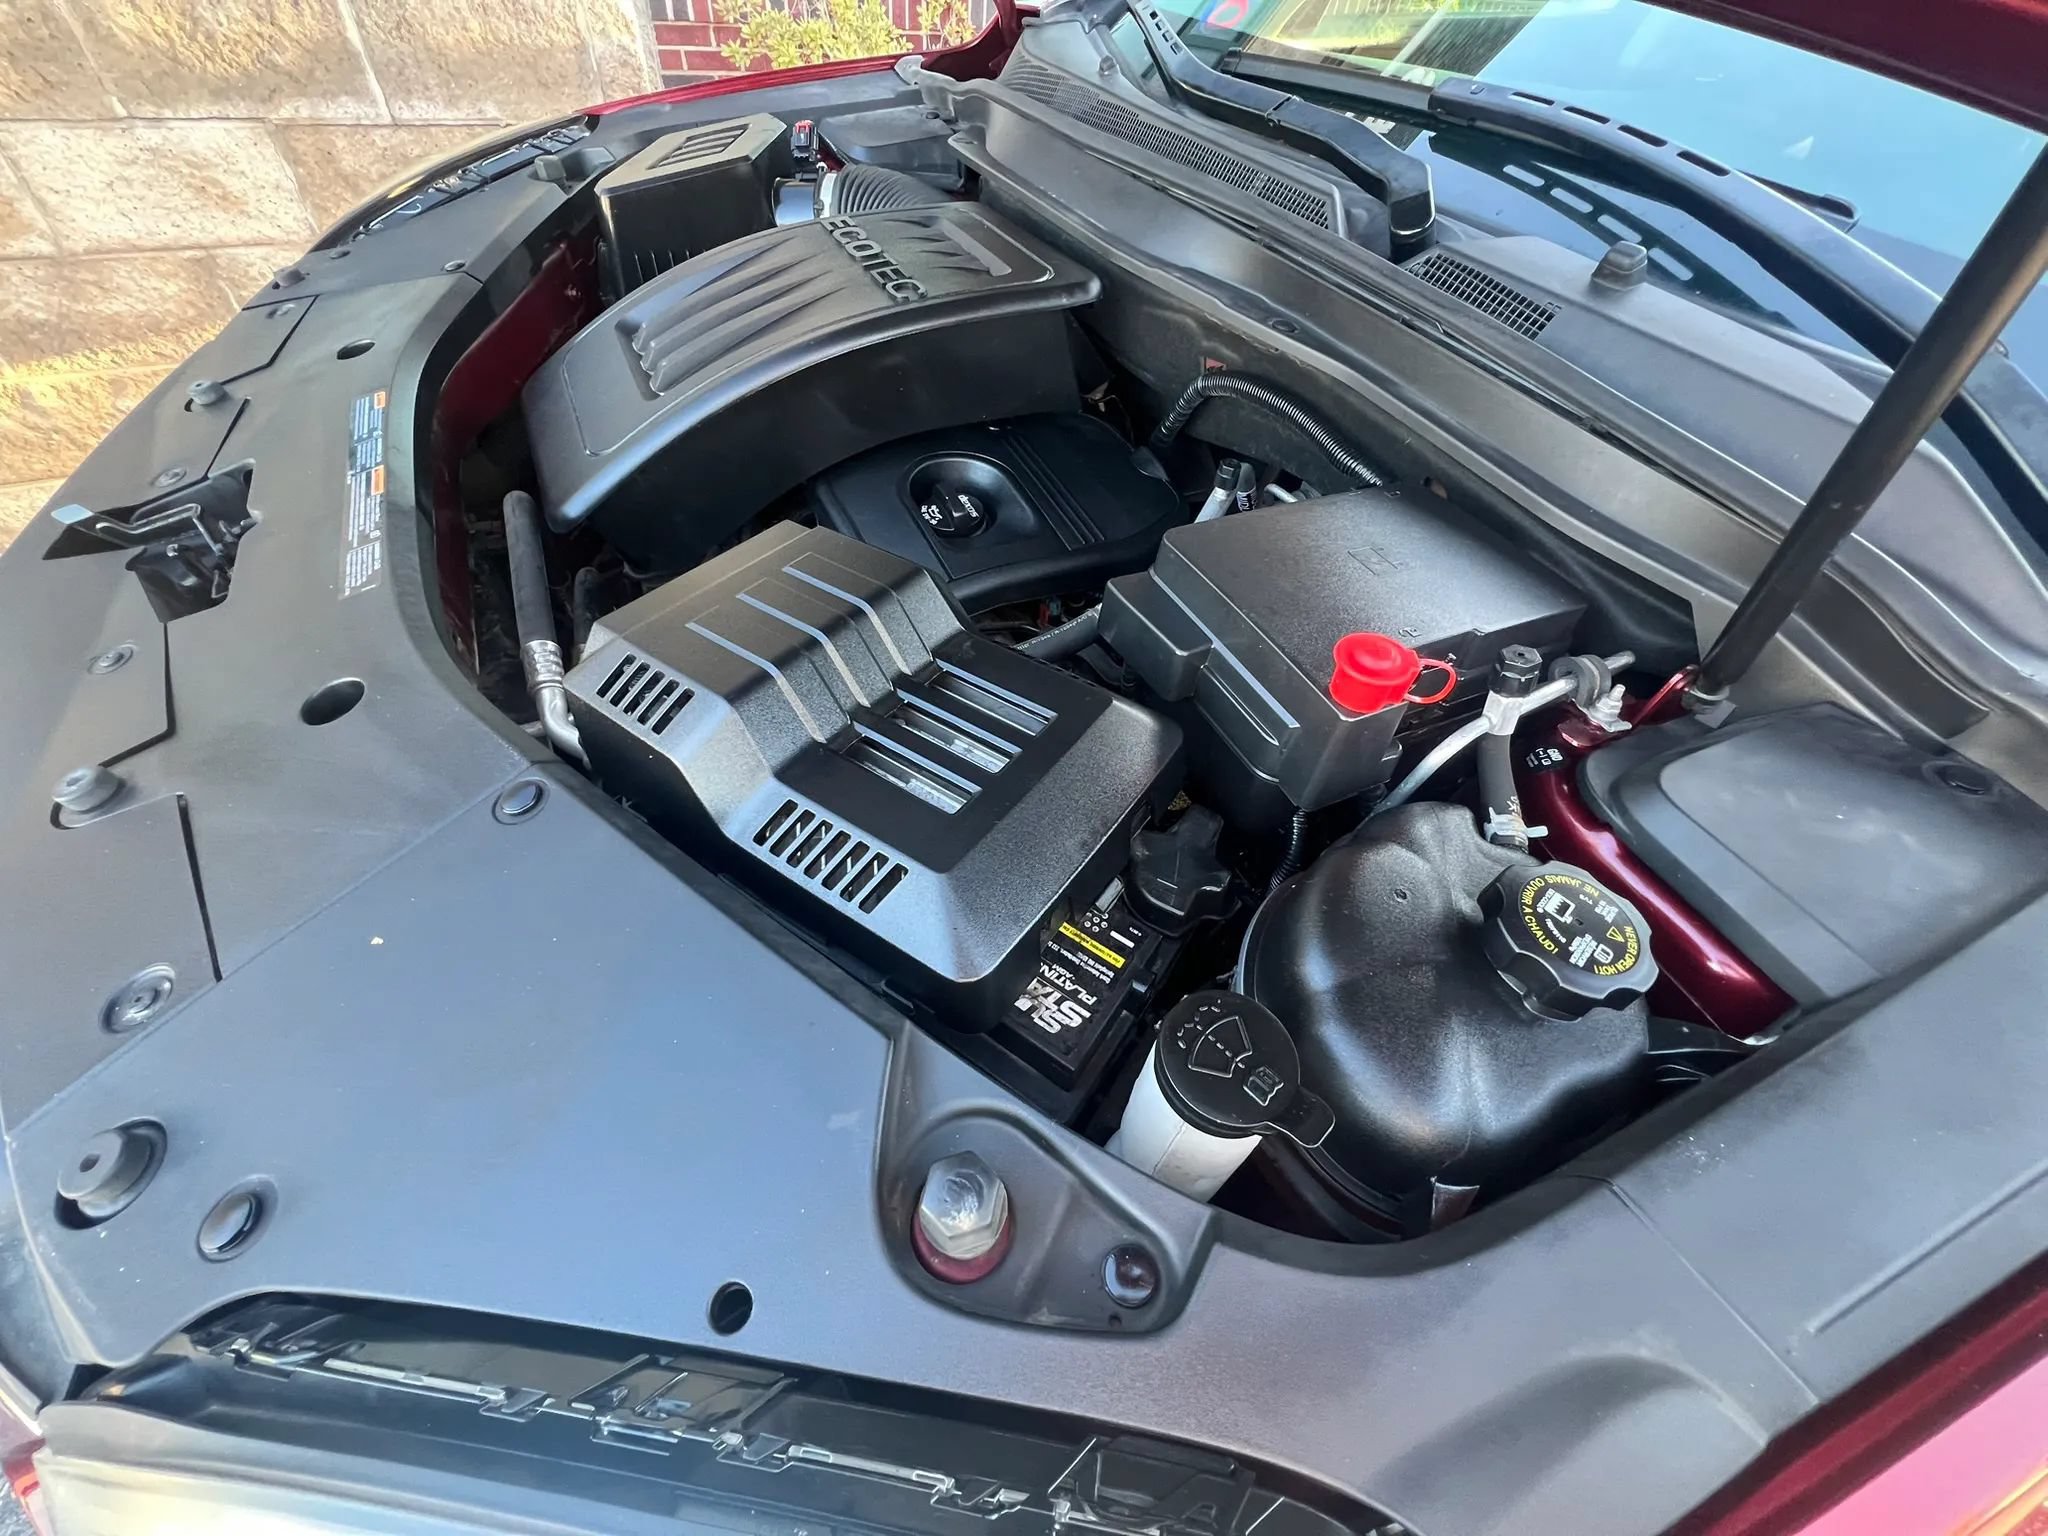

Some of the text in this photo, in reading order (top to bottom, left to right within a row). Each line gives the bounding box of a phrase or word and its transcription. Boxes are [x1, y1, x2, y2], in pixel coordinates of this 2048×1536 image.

[820, 216, 928, 304] ECOTEC
[957, 494, 980, 518] dexos
[1521, 877, 1545, 905] OUVRIR
[1544, 874, 1582, 888] JAMAIS
[1583, 884, 1600, 897] NE
[1623, 925, 1638, 953] NEVER
[1052, 963, 1075, 980] AGM
[1614, 953, 1636, 972] OPEN
[1040, 962, 1098, 1006] PLATIN
